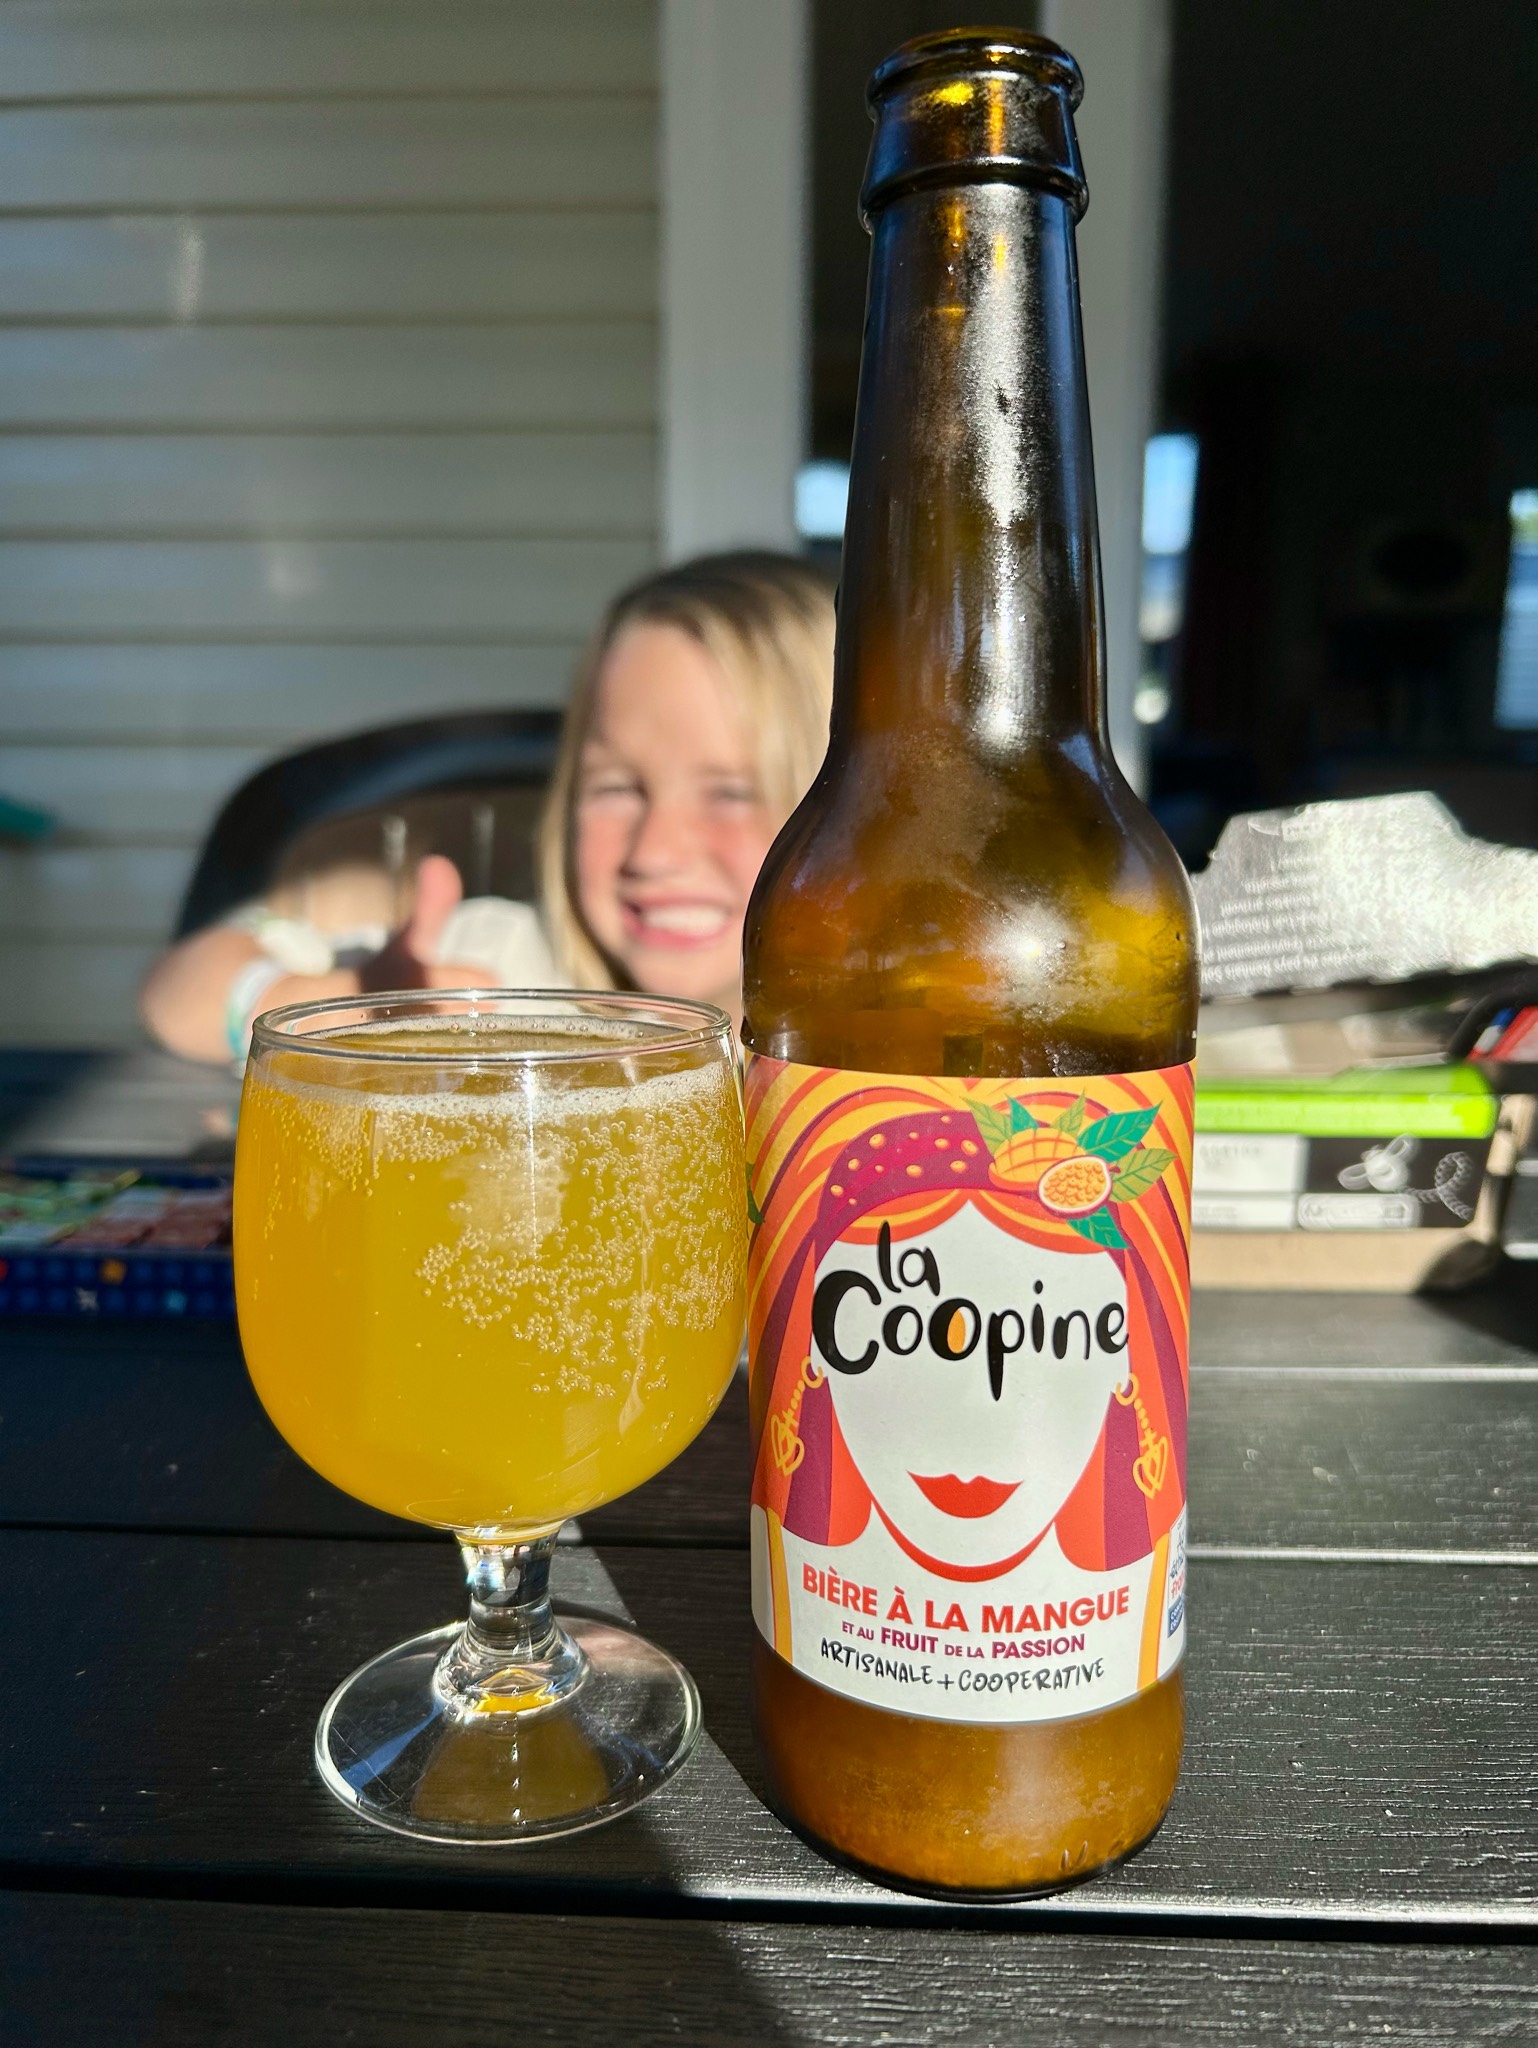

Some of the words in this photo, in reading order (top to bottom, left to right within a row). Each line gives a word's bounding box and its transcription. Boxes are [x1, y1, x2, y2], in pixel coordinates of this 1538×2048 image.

[877, 1220, 940, 1296] la
[812, 1270, 1130, 1401] Coopine
[802, 1562, 877, 1617] BIÈRE
[886, 1585, 913, 1625] À
[925, 1600, 969, 1632] LA
[981, 1585, 1129, 1633] MANGUE
[821, 1637, 933, 1684] ARTISANALE
[958, 1658, 1104, 1693] COOPERATIVE
[842, 1621, 853, 1634] ET
[857, 1625, 875, 1640] AU
[881, 1626, 938, 1654] FRUIT
[944, 1643, 963, 1657] DE
[966, 1646, 985, 1658] LA
[991, 1633, 1085, 1659] PASSION
